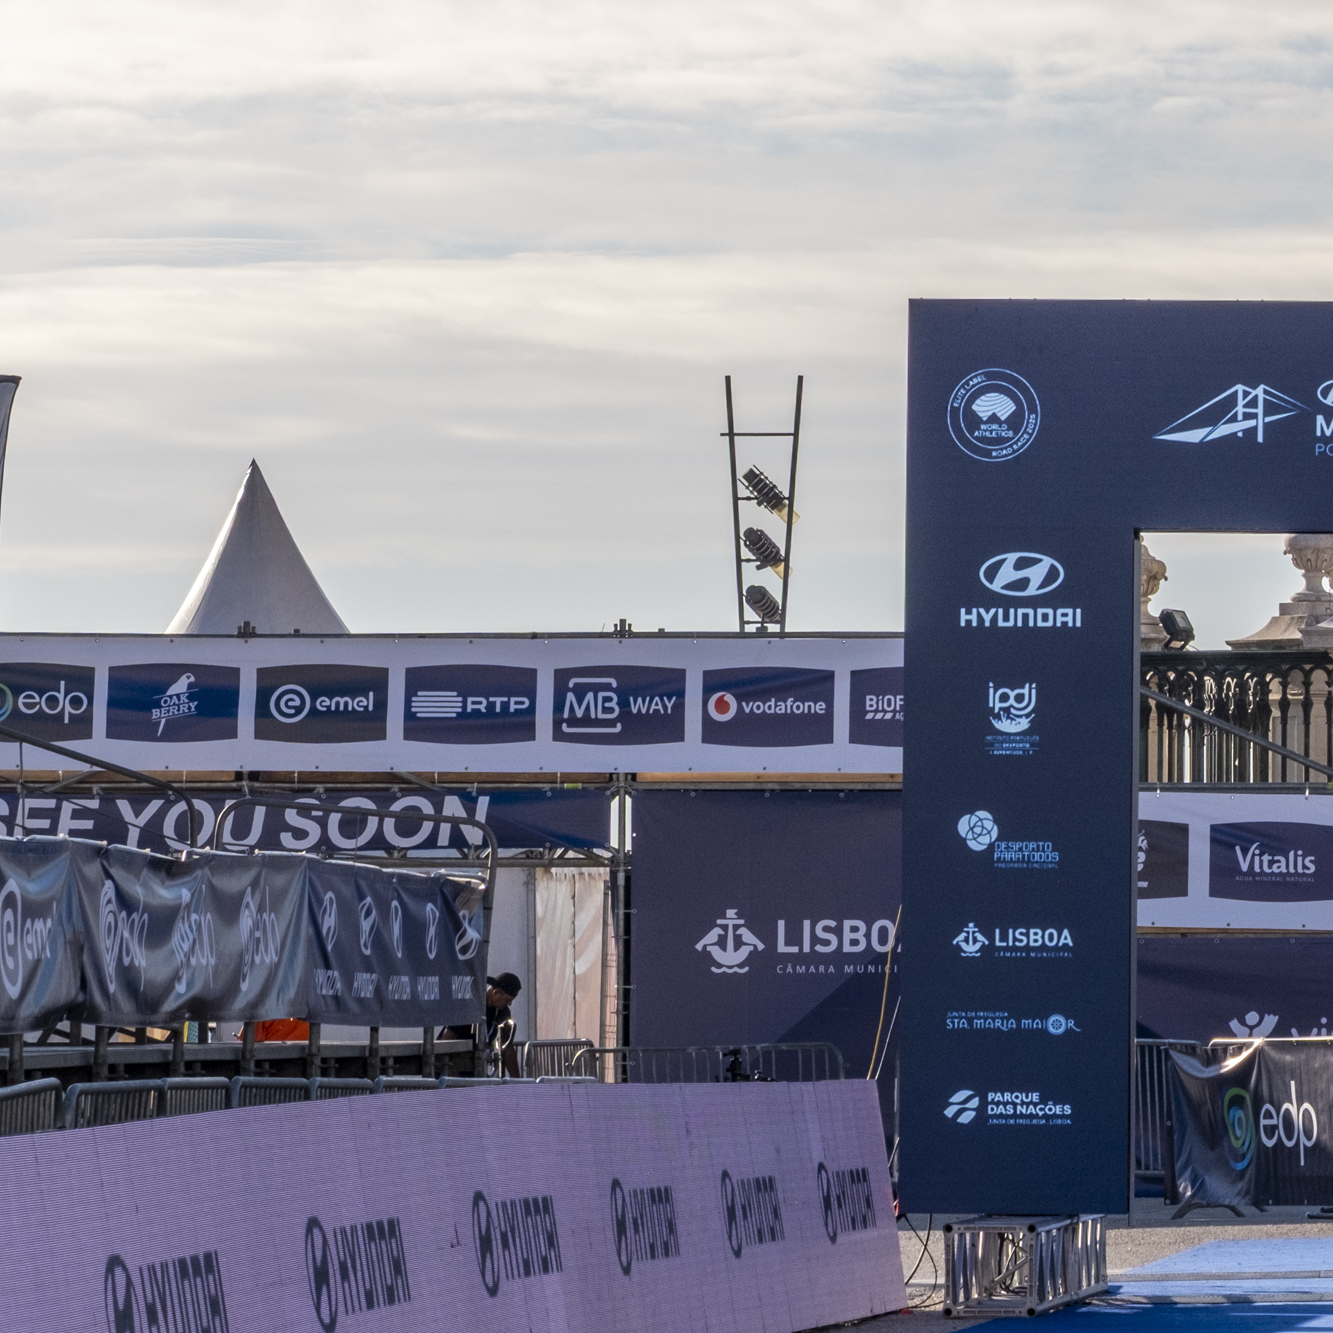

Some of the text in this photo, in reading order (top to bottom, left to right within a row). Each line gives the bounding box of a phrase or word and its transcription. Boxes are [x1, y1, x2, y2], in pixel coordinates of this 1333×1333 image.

[953, 374, 987, 407] ELITE LABEL
[991, 447, 1013, 457] ROAD
[960, 608, 1081, 627] HYUNDAI
[18, 680, 88, 723] edp
[160, 693, 190, 707] OAK
[315, 691, 374, 712] emel
[466, 696, 530, 713] RTP
[563, 691, 677, 719] MB WAY
[742, 698, 826, 714] vodafone
[988, 681, 1036, 715] ipdj
[152, 701, 198, 719] BERRY
[115, 799, 266, 850] YOU
[280, 795, 490, 850] SOON
[994, 841, 1052, 852] DESPORTO
[994, 852, 1059, 862] PARATODOS
[1235, 842, 1316, 874] Vitalis
[777, 919, 902, 953] LISBO
[995, 928, 1073, 947] LISBOA
[776, 963, 898, 974] CÂMARA MUNICI
[946, 1019, 970, 1029] STA.
[973, 1019, 1016, 1031] MARIA
[987, 1092, 1040, 1103] PARQUE
[987, 1101, 1071, 1116] DAS NAÇÕES
[1259, 1080, 1317, 1166] edp
[737, 1175, 785, 1246] HYUNDAI
[628, 1185, 680, 1262] HYUNDAI
[495, 1195, 563, 1281] HYUNDAI
[333, 1215, 411, 1316] HYUNDAI
